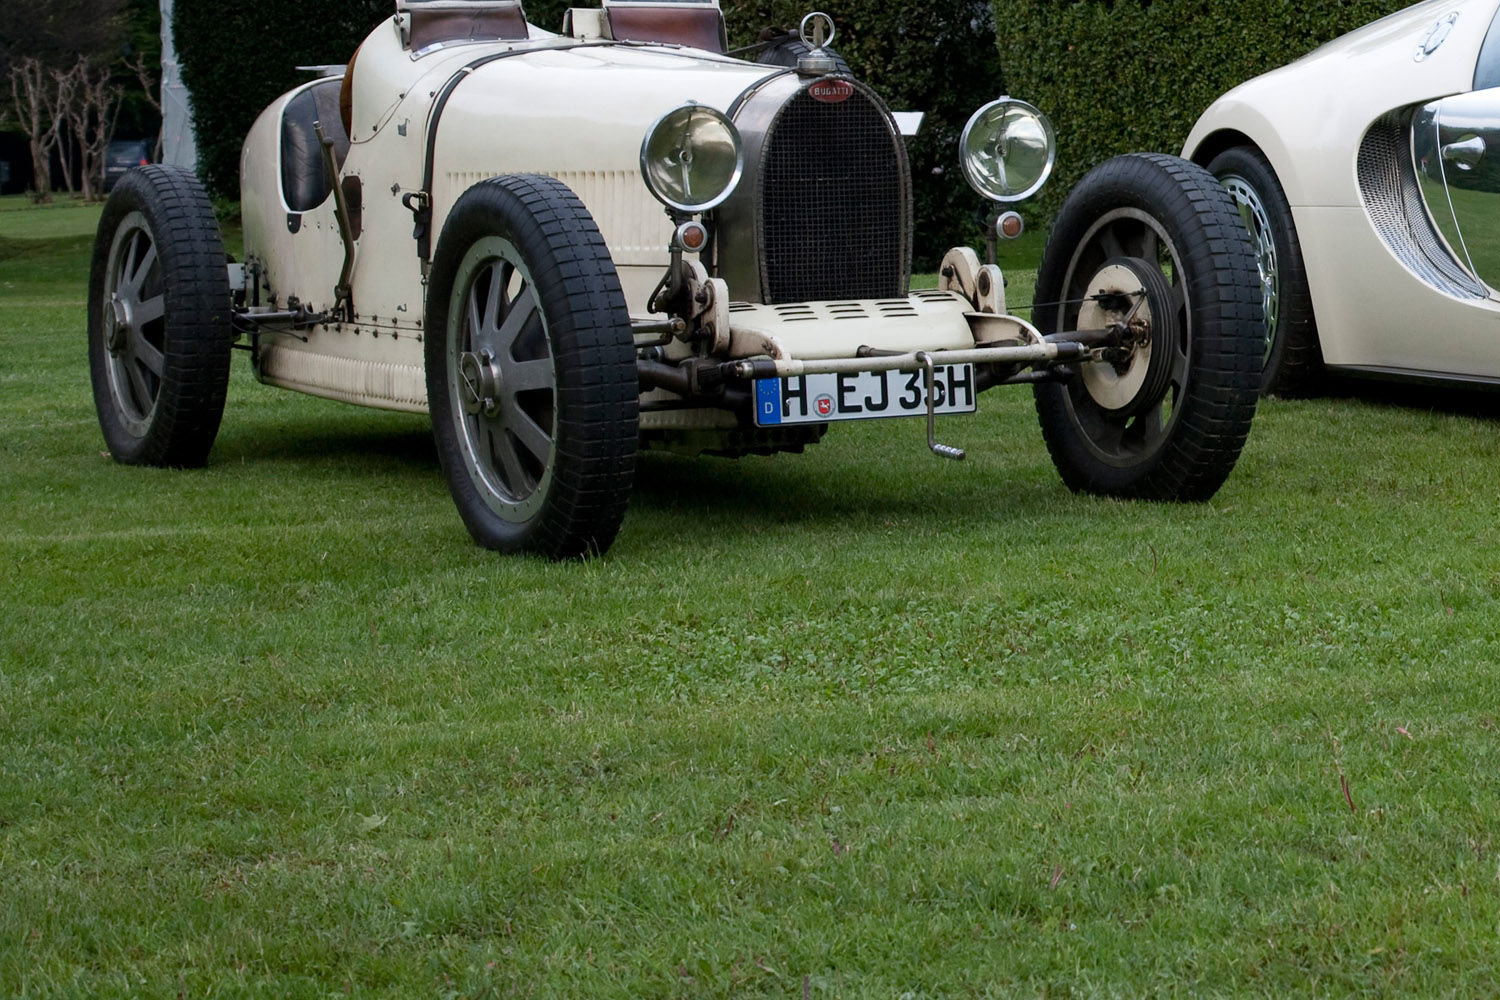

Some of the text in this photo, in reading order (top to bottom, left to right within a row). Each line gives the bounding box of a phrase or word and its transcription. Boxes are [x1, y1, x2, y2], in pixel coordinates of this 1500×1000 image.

[814, 87, 849, 95] BUGATTI
[782, 374, 808, 417] H
[764, 402, 774, 414] D
